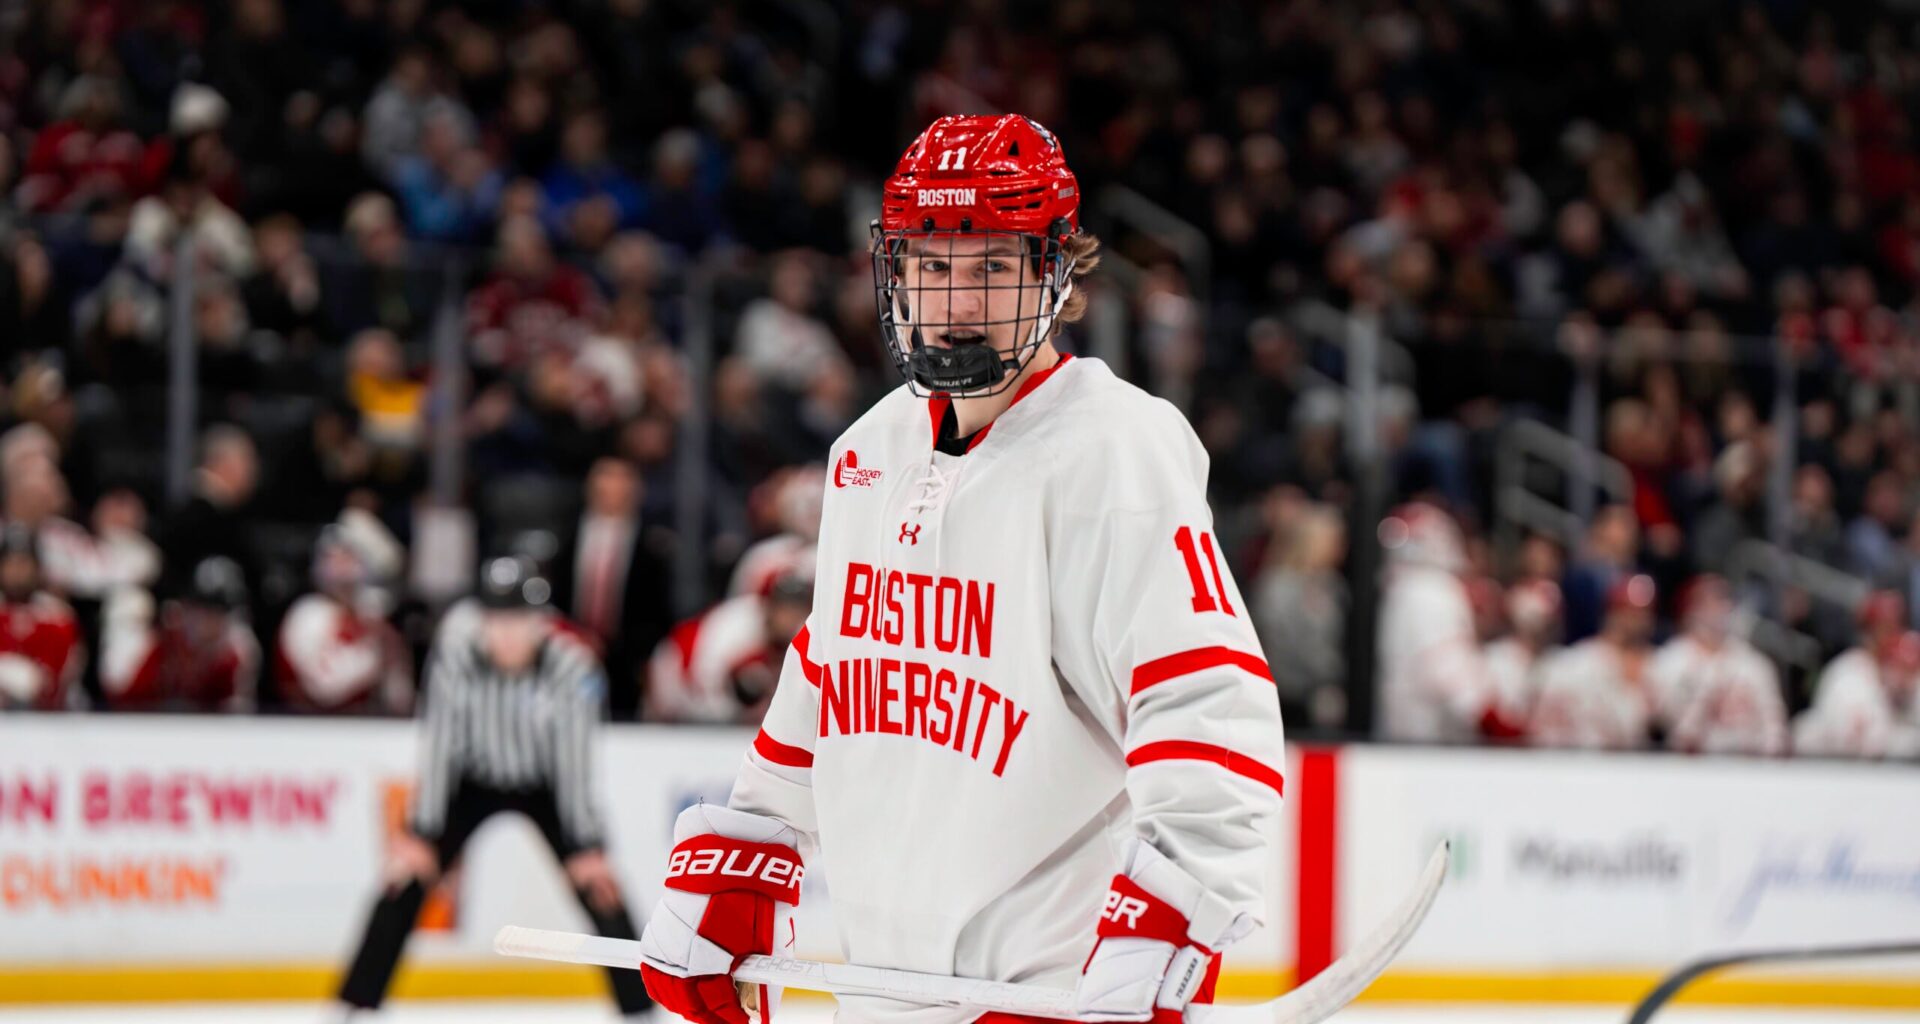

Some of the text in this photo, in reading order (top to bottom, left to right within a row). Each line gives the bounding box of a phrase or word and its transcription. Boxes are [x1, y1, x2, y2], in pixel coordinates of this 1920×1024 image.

[937, 146, 968, 171] 11
[917, 188, 977, 207] BOSTON
[1174, 525, 1237, 618] 11
[819, 657, 1030, 778] NIVERSITY
[0, 772, 59, 830] N
